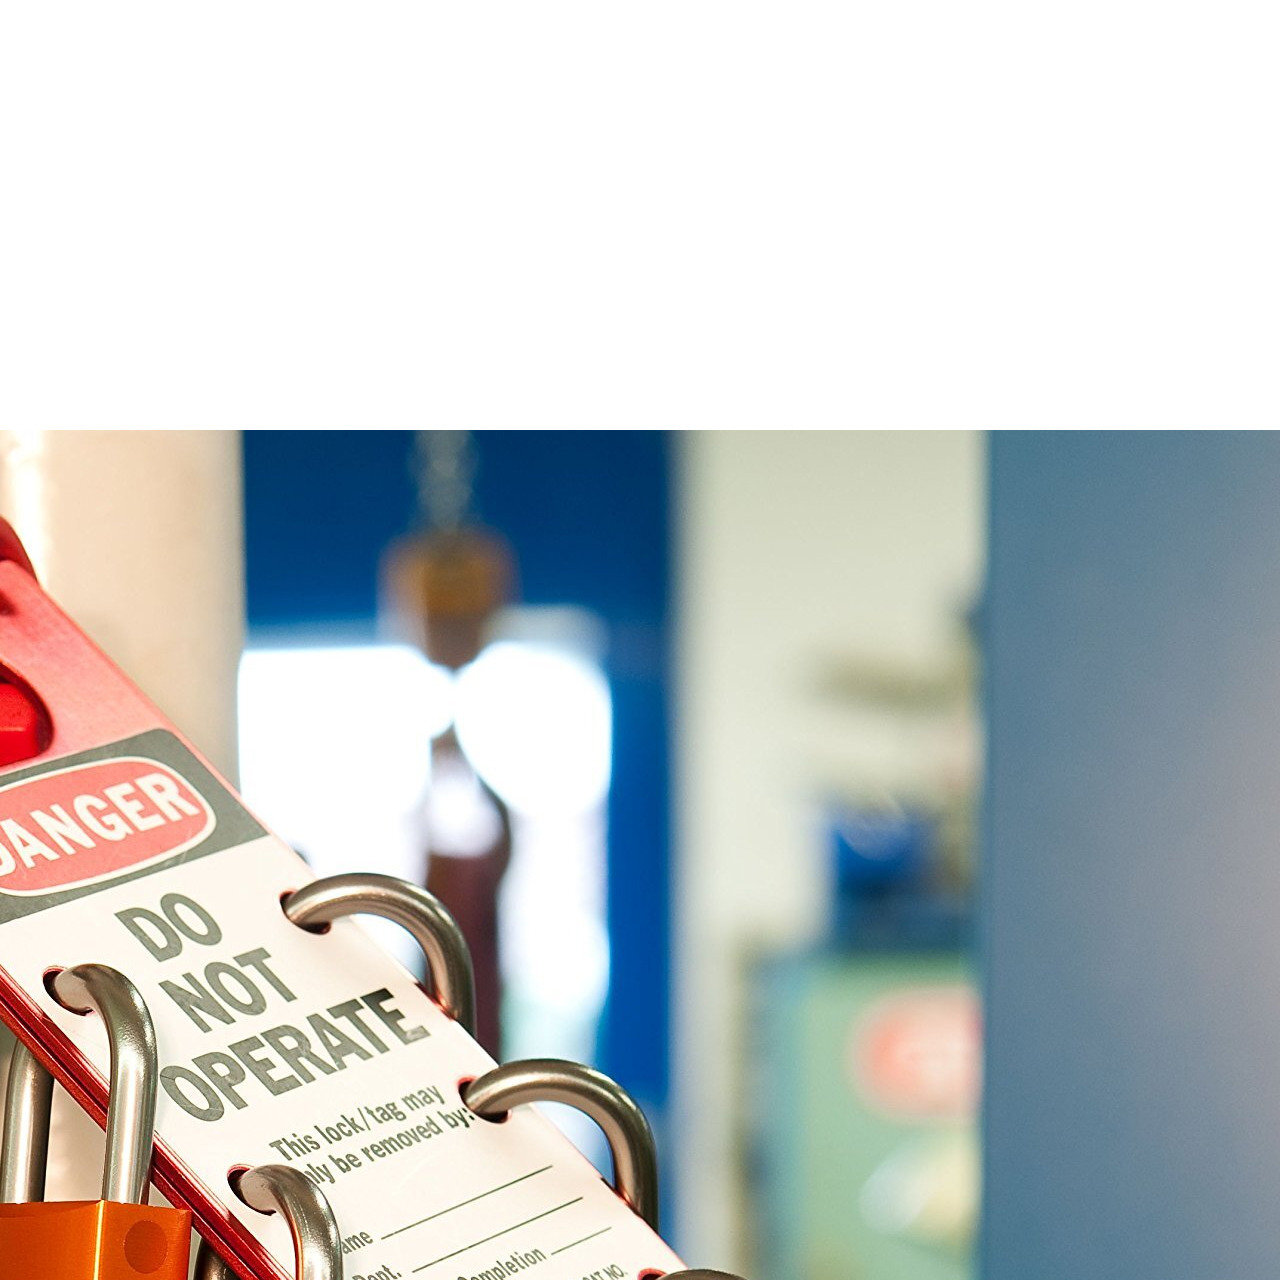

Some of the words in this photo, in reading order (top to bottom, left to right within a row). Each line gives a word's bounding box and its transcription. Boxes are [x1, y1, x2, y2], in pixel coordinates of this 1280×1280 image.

[114, 893, 222, 962] DO
[159, 947, 299, 1034] NOT
[159, 988, 431, 1122] OPERATE
[269, 1132, 320, 1161] This
[314, 1101, 406, 1144] lock/tag
[401, 1085, 446, 1111] may
[304, 1163, 336, 1184] nly
[328, 1152, 363, 1174] be
[361, 1115, 443, 1162] removed
[437, 1107, 476, 1128] by:
[341, 1231, 373, 1254] ame
